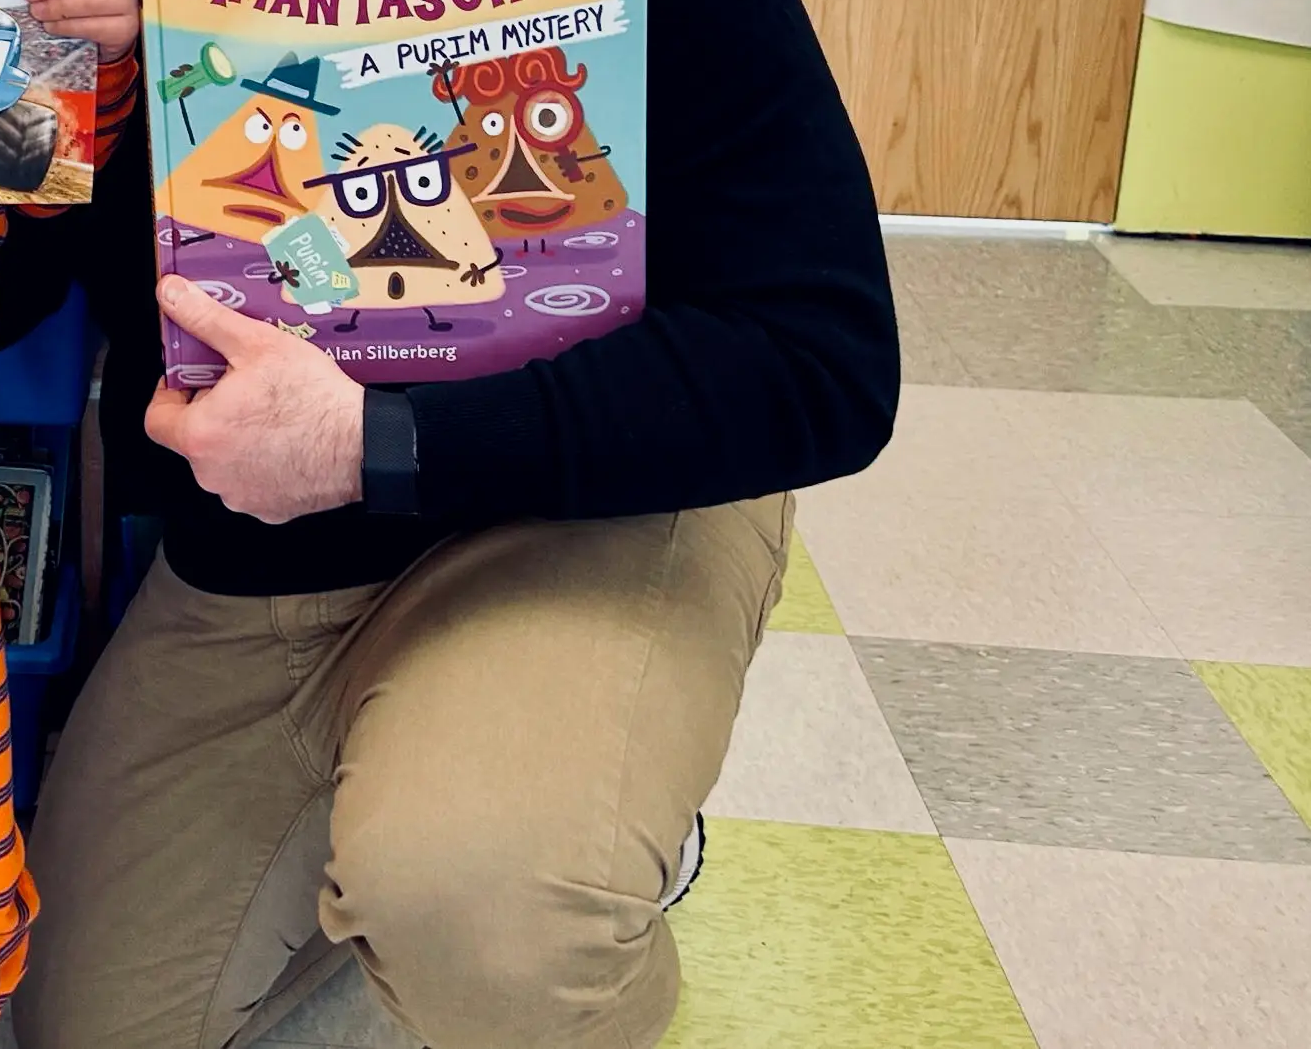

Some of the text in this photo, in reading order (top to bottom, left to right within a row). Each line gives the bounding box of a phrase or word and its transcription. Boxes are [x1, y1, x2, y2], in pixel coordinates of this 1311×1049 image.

[360, 4, 604, 77] A PURIM MYSTERY
[366, 345, 457, 362] Silberberg
